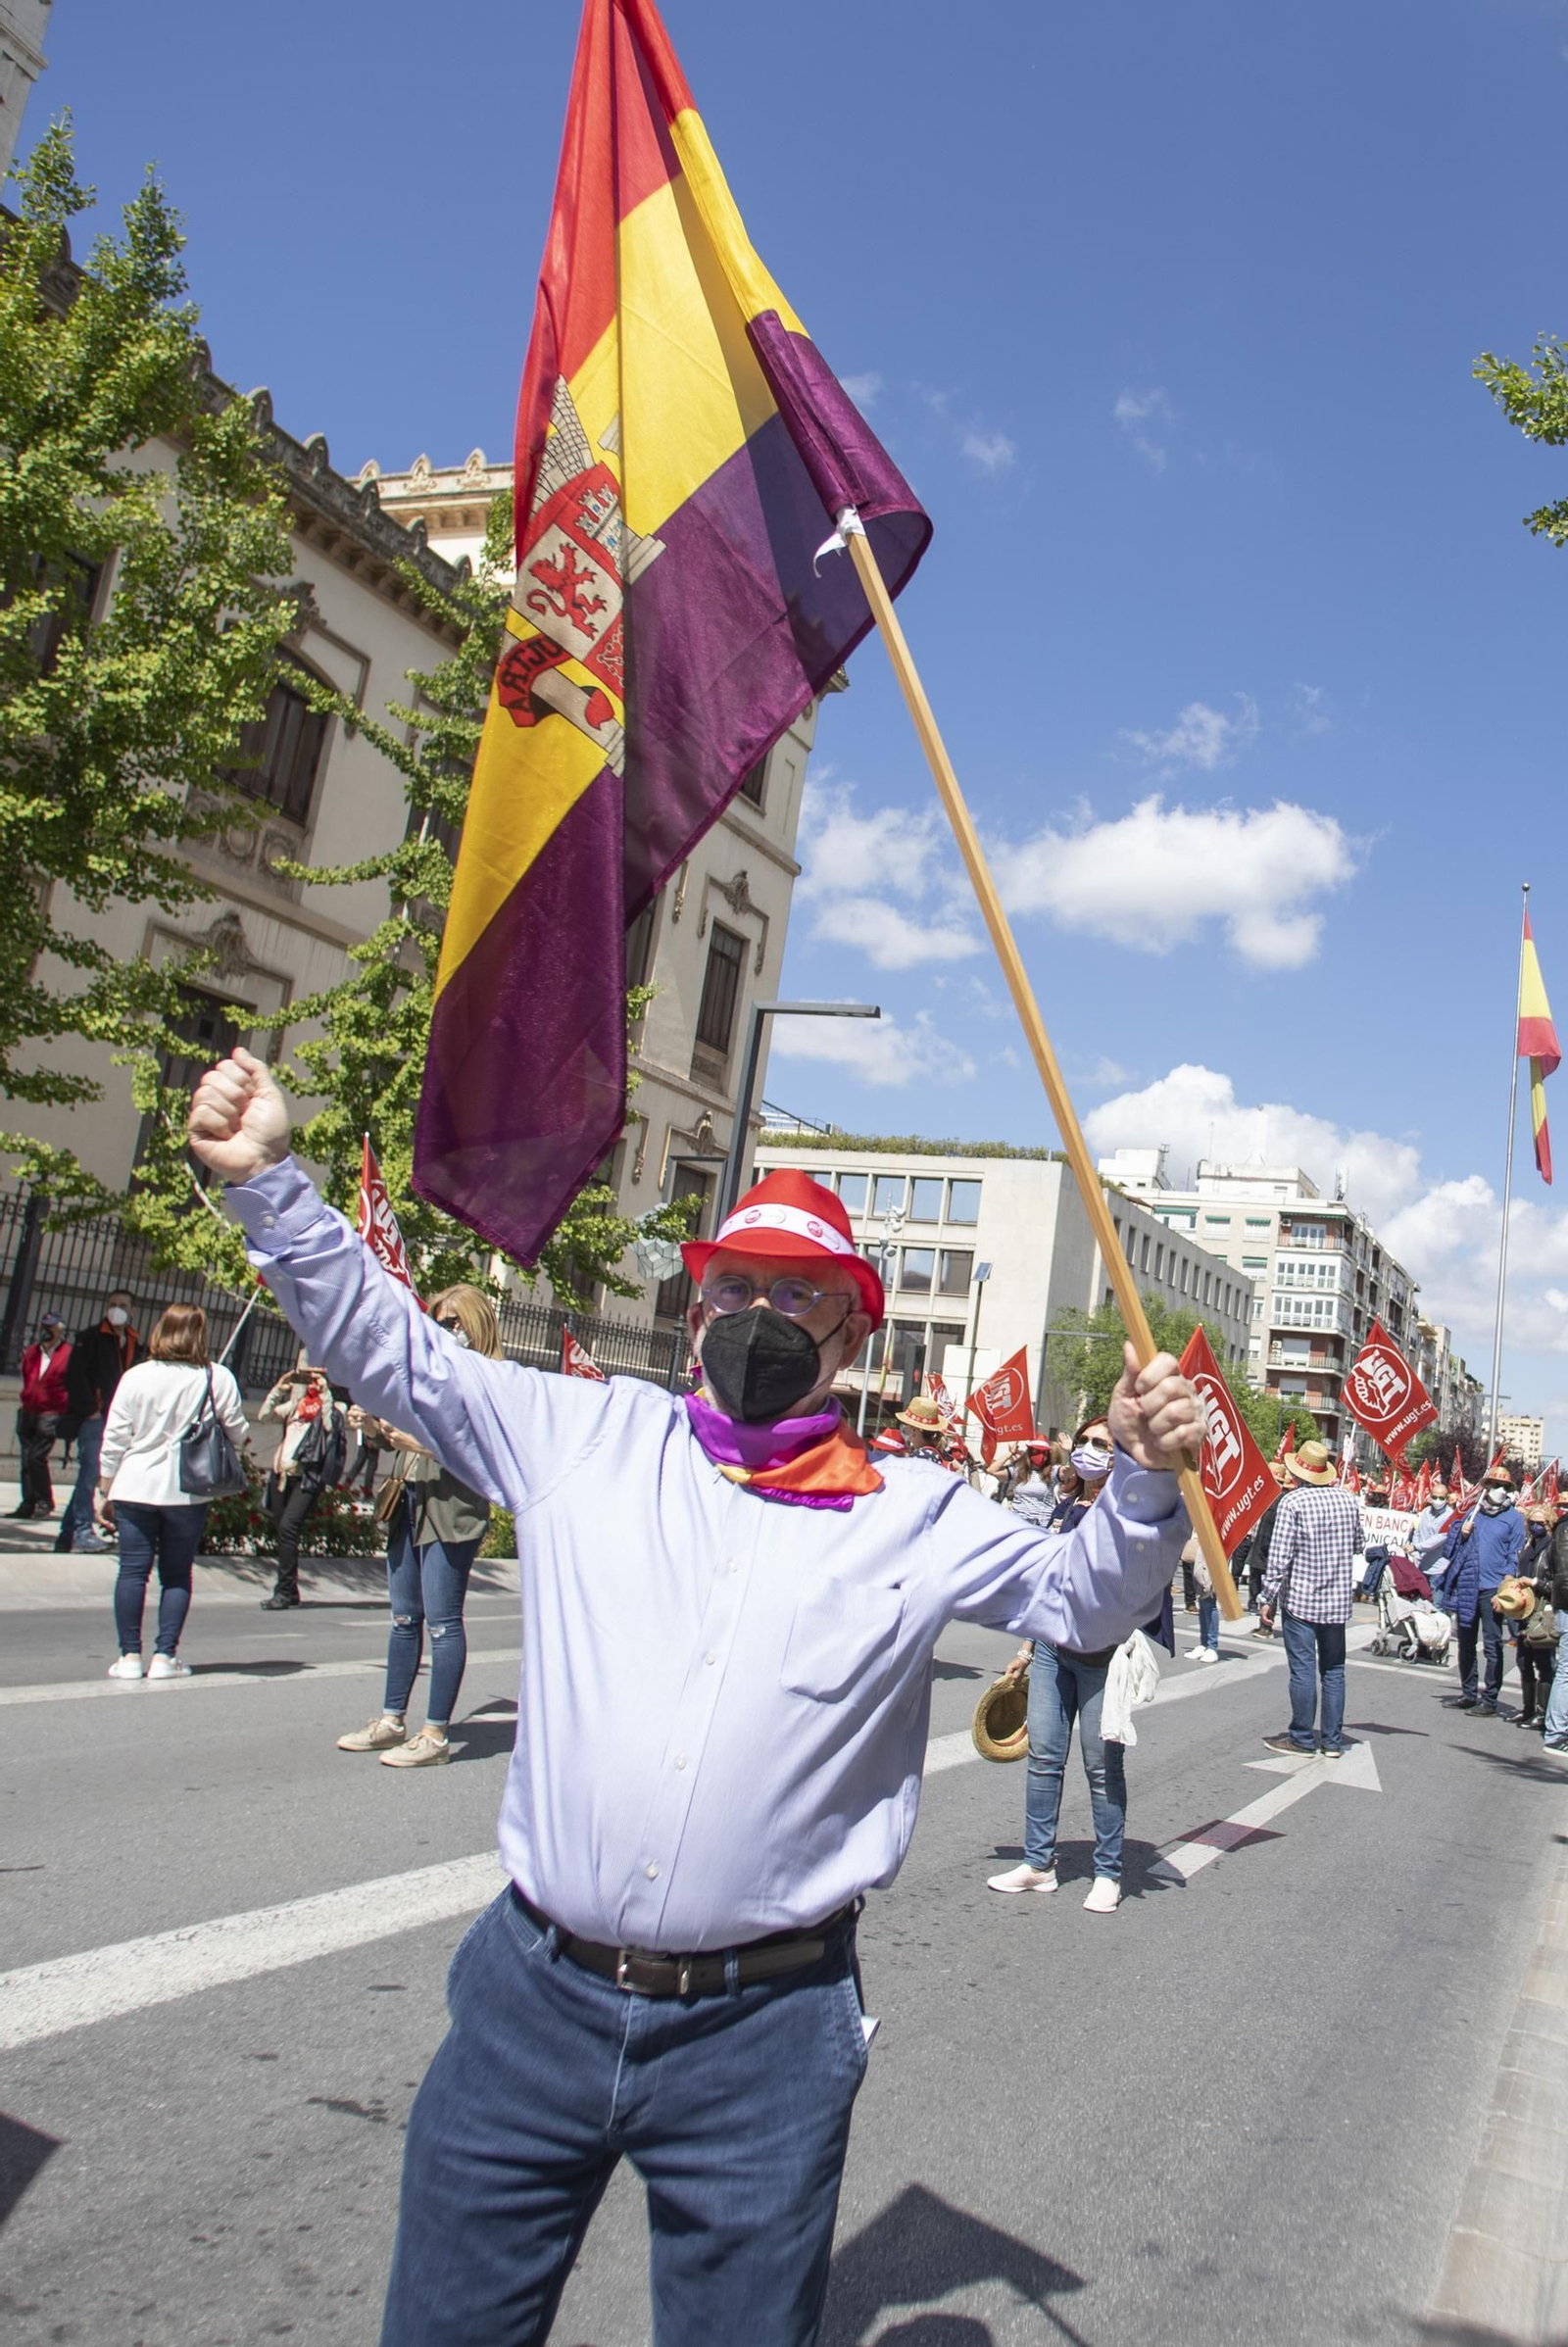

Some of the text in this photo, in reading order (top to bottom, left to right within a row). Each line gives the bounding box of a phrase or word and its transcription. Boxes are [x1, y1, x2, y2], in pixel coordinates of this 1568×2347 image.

[1359, 1348, 1407, 1404] UGT
[1197, 1383, 1241, 1474] UGT
[1383, 1399, 1432, 1444] www.ugt.es
[1220, 1475, 1265, 1540] www.ugt.es
[1363, 1533, 1409, 1547] UNICAJ
